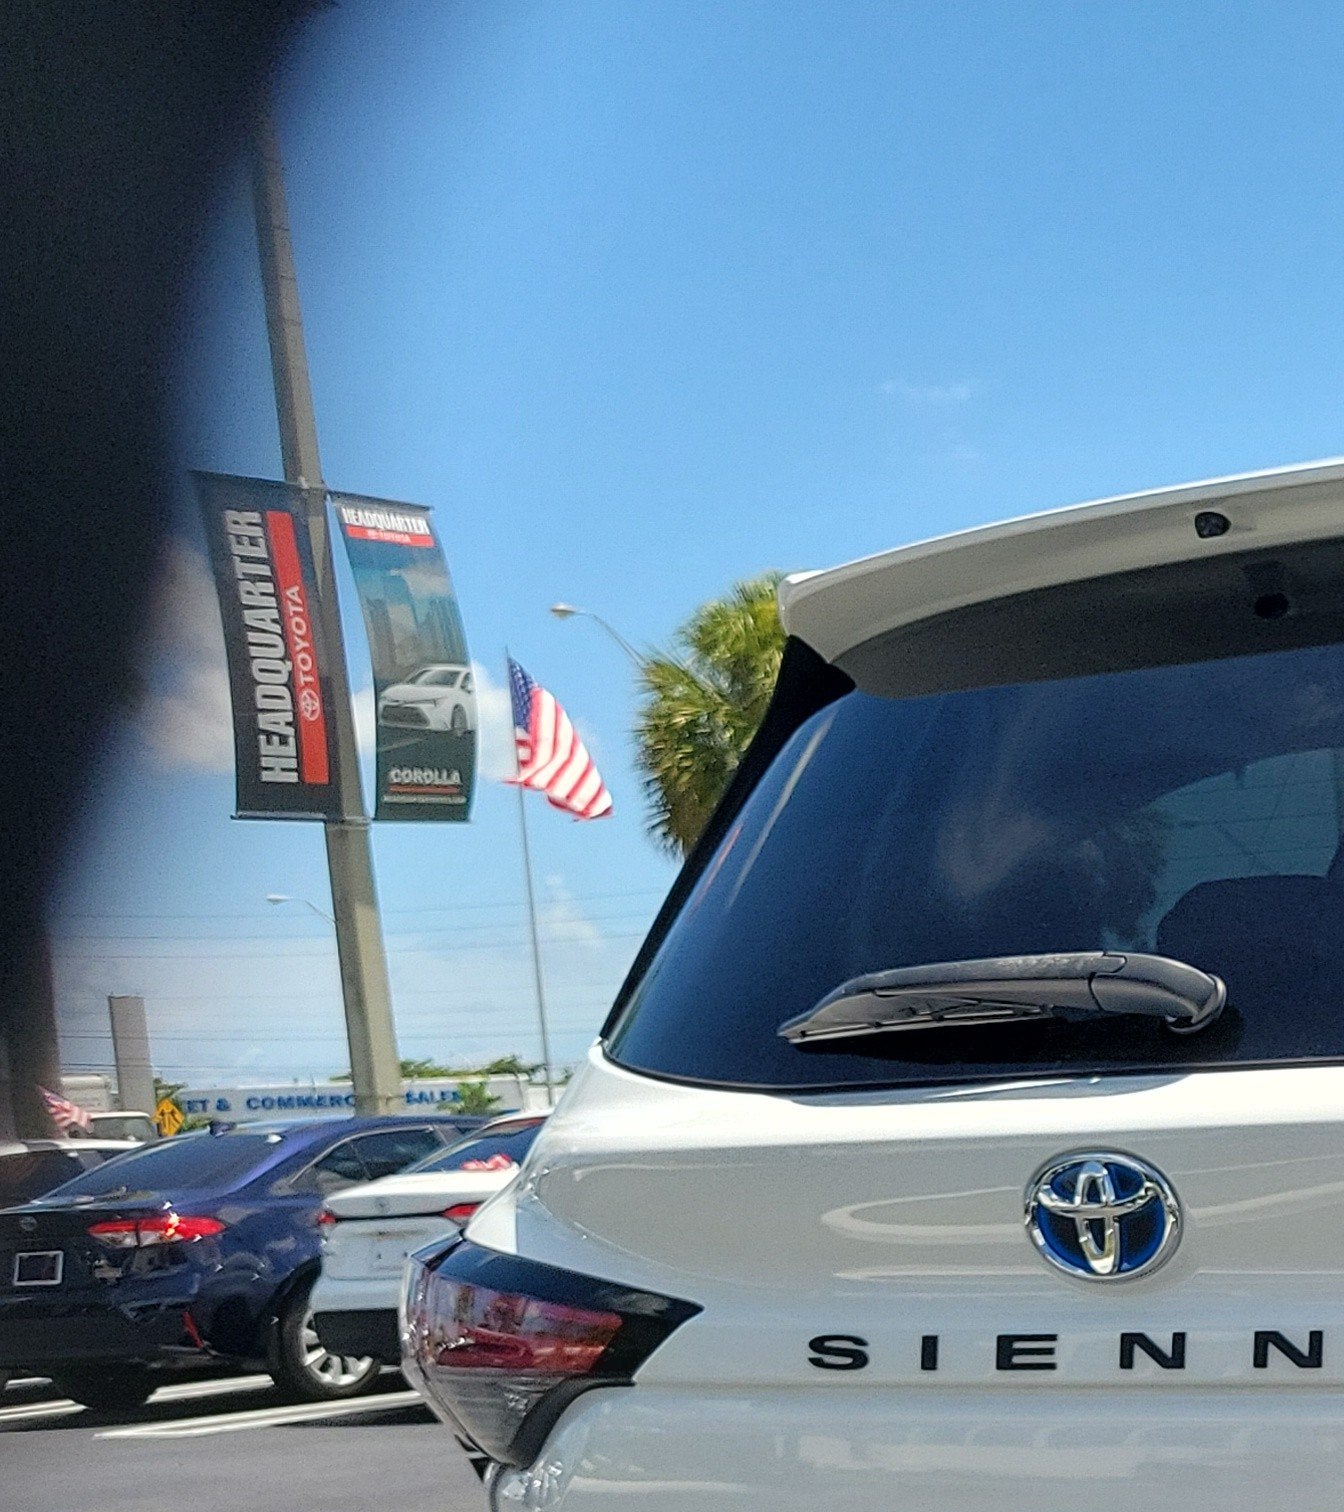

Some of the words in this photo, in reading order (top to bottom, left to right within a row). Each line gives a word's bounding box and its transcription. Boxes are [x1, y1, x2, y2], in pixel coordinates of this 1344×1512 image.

[224, 509, 300, 784] HEADQUARTER
[285, 585, 315, 686] TOYOTA
[389, 768, 461, 785] COROLLA
